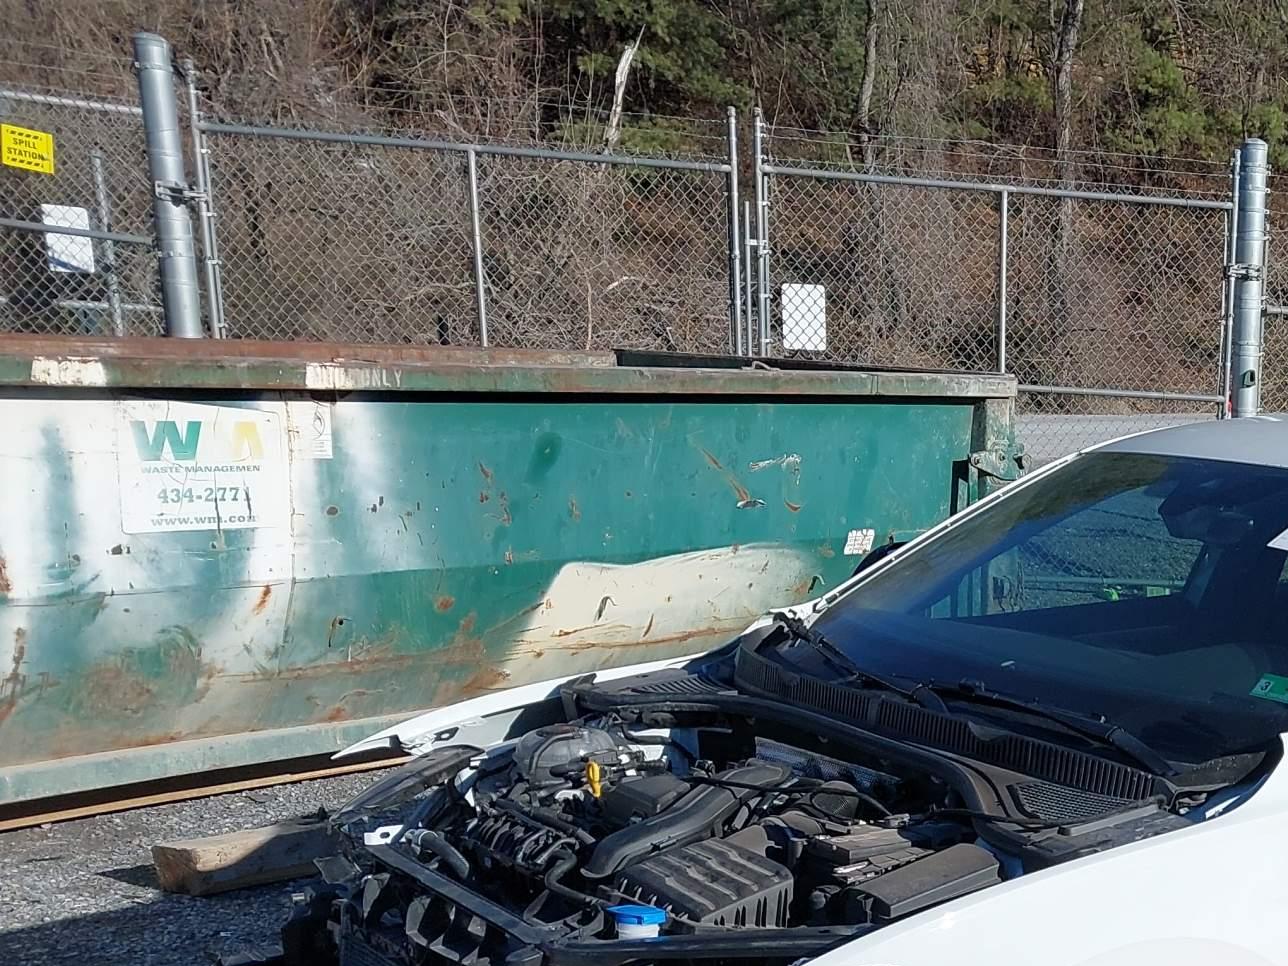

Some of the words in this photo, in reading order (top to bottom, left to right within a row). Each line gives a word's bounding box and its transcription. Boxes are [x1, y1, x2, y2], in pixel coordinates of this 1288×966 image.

[12, 138, 38, 150] SPILL
[6, 146, 46, 161] STATION
[140, 465, 181, 474] WASTE
[184, 464, 261, 473] MANAGEMEN
